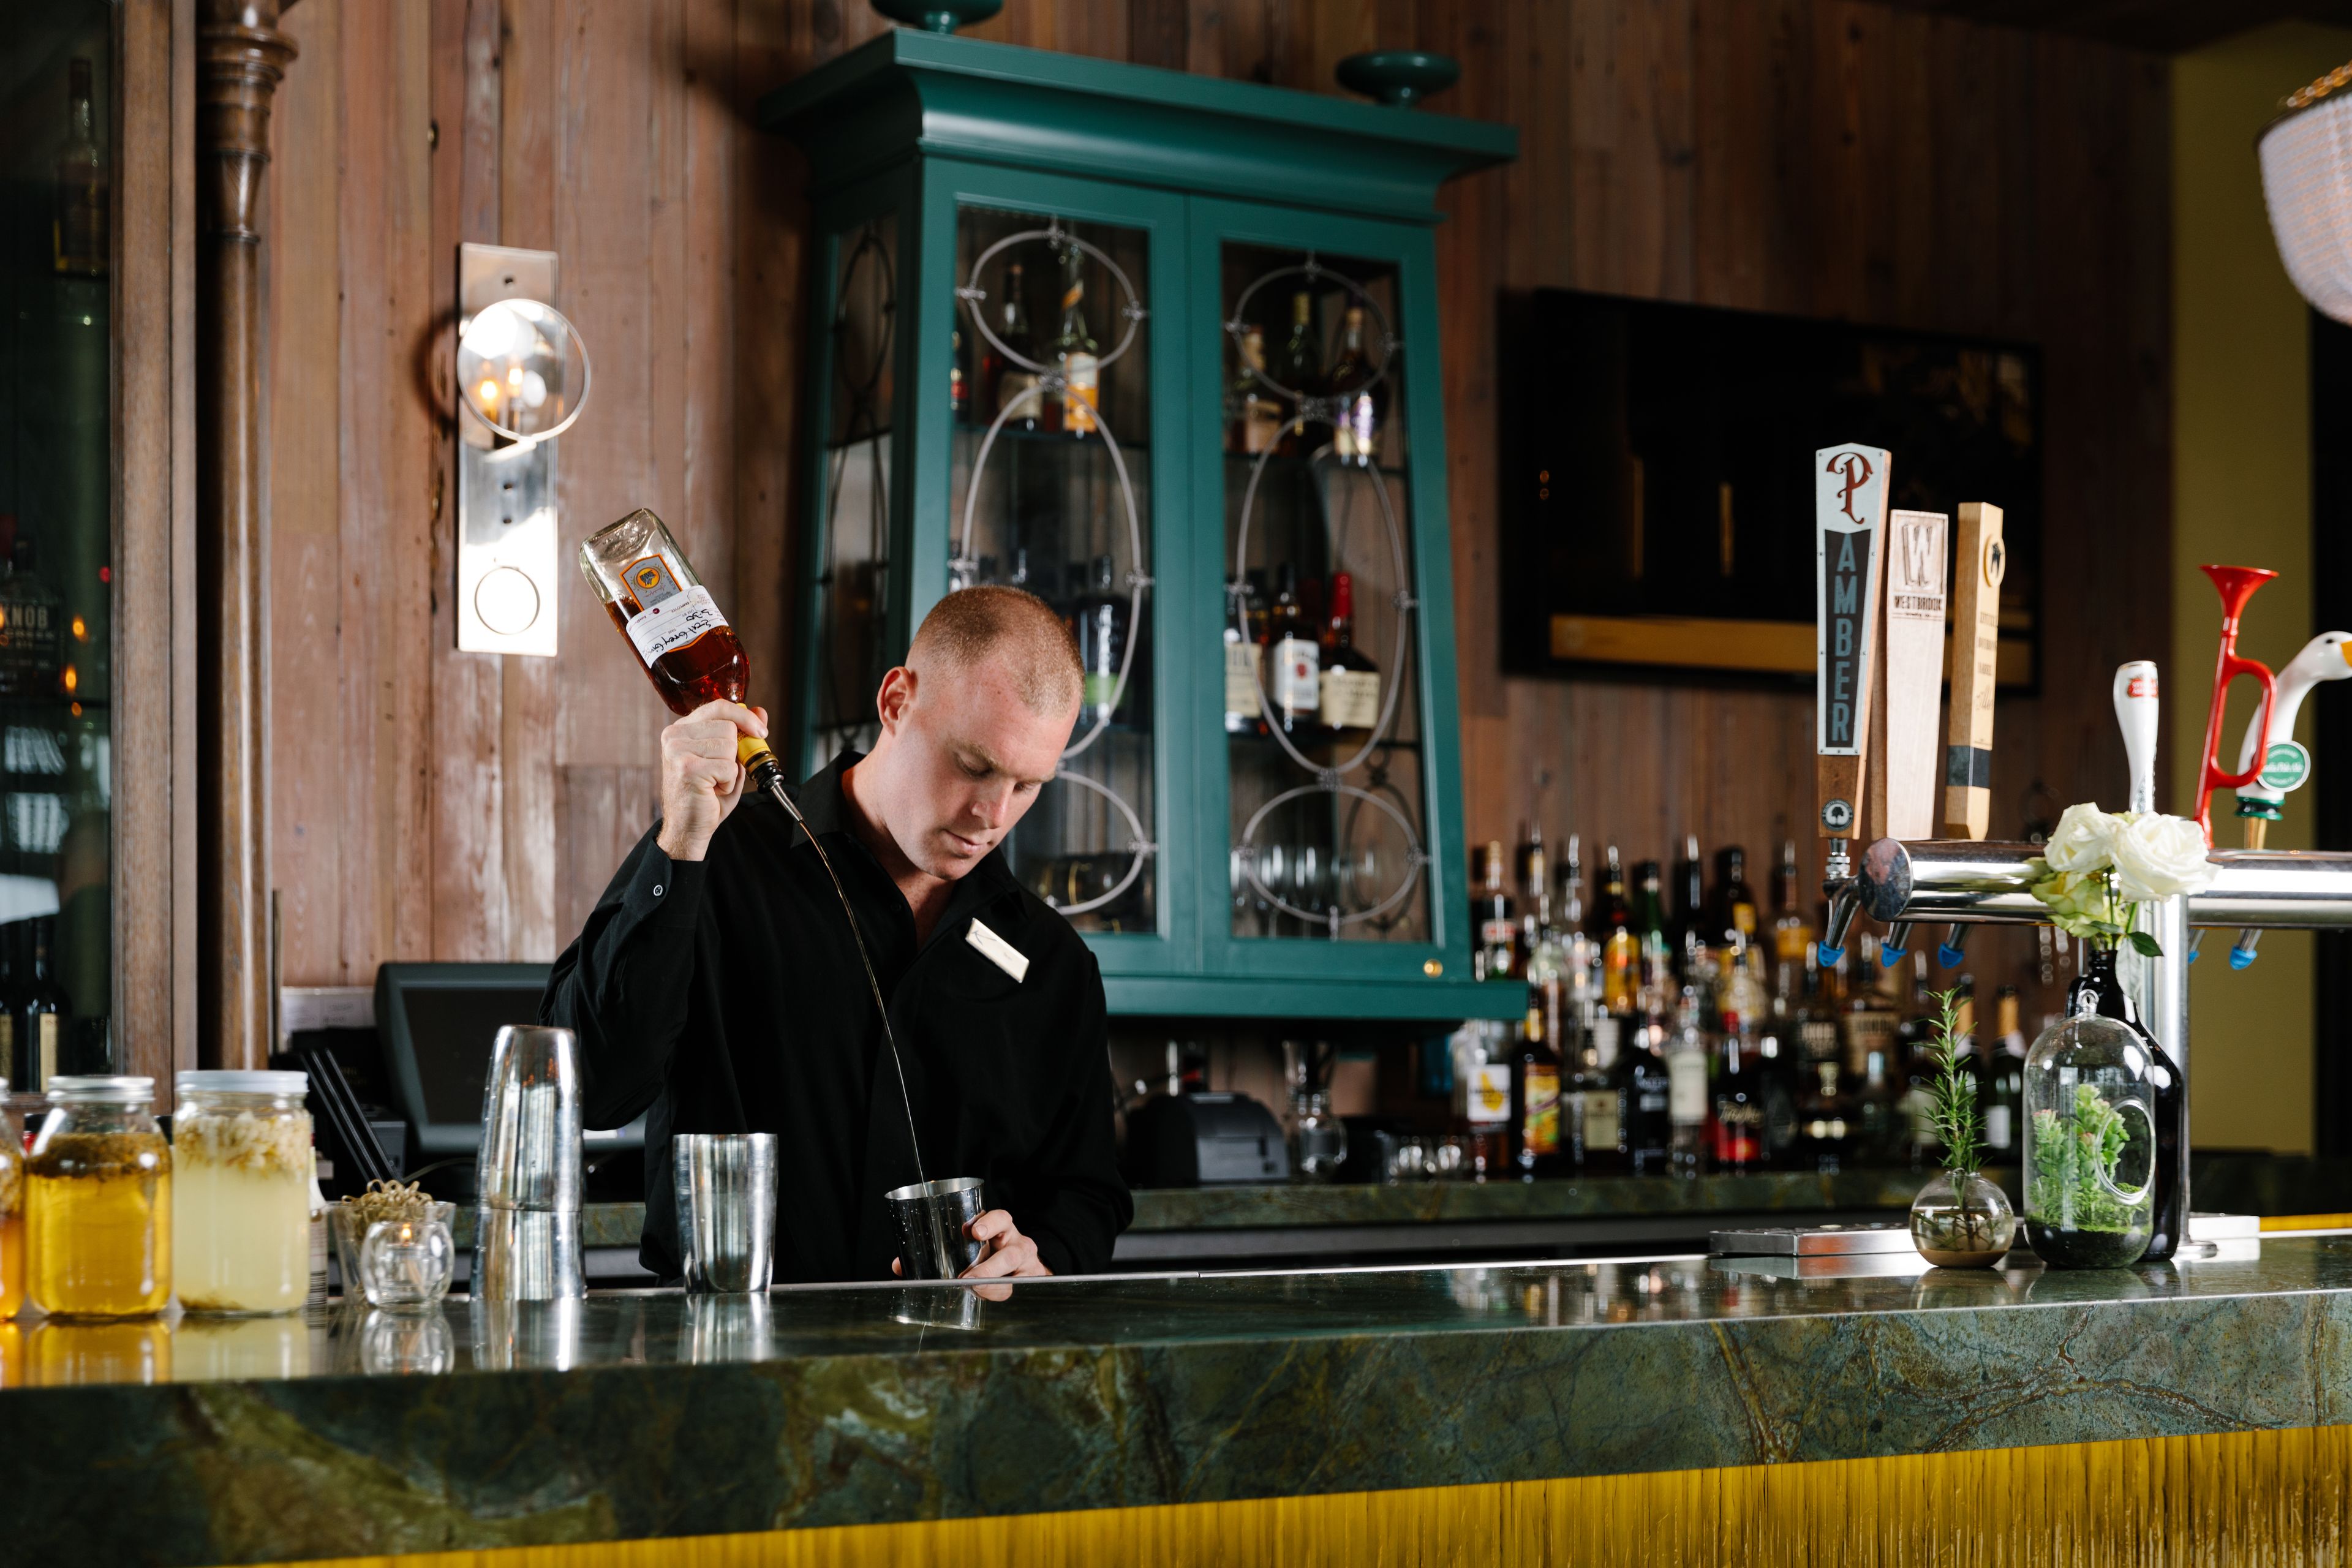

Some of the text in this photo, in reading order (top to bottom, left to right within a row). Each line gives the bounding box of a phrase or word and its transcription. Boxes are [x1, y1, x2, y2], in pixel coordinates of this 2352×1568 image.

[1826, 452, 1873, 524] P
[1894, 595, 1942, 611] WESTBROOK
[661, 631, 687, 645] Grey
[1831, 533, 1858, 742] AMBER
